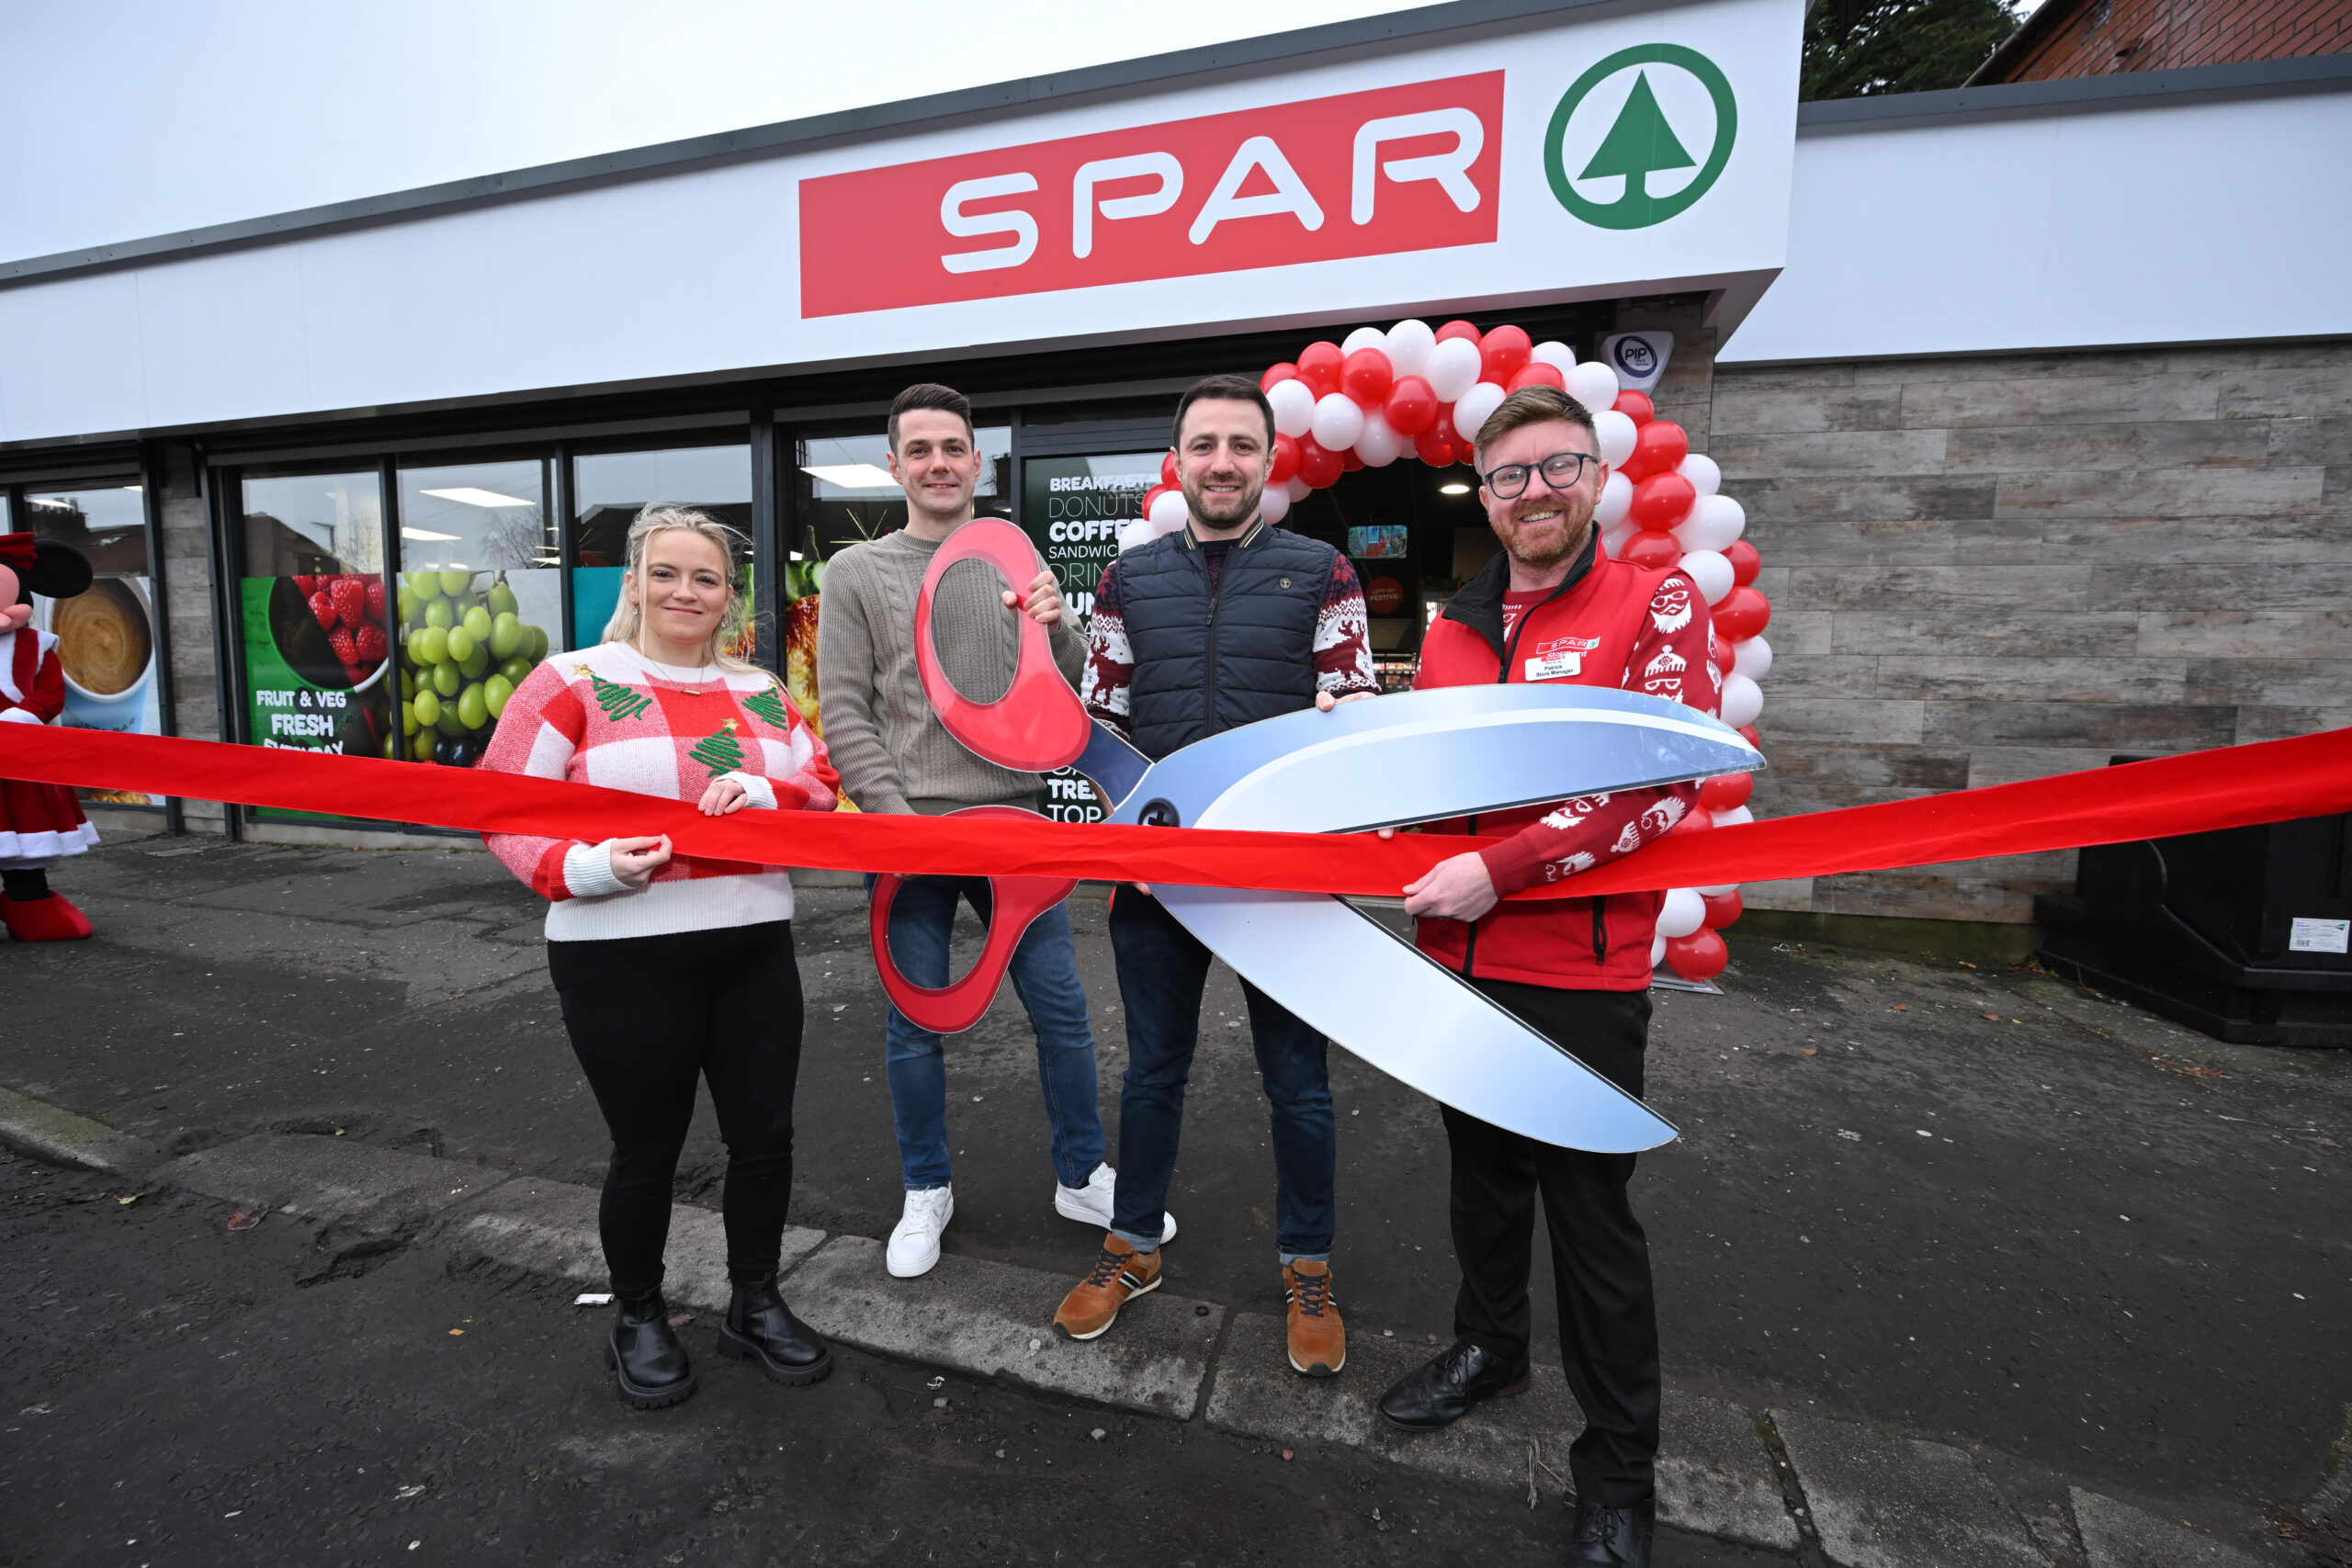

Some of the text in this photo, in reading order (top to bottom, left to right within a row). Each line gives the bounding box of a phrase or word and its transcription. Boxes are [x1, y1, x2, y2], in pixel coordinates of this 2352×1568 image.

[940, 107, 1485, 275] SPAR
[1625, 347, 1646, 360] PIP
[1049, 473, 1148, 491] BREAKFAST
[1048, 493, 1145, 518] DONUTS
[1048, 519, 1131, 543] COFFE
[1048, 545, 1120, 558] SANDWIC
[1049, 562, 1103, 586] DRIN
[1551, 639, 1587, 649] SPAR
[256, 690, 347, 708] FRUIT & VEG
[271, 714, 334, 737] FRESH
[1047, 779, 1098, 800] TRE
[1046, 805, 1102, 824] TOP
